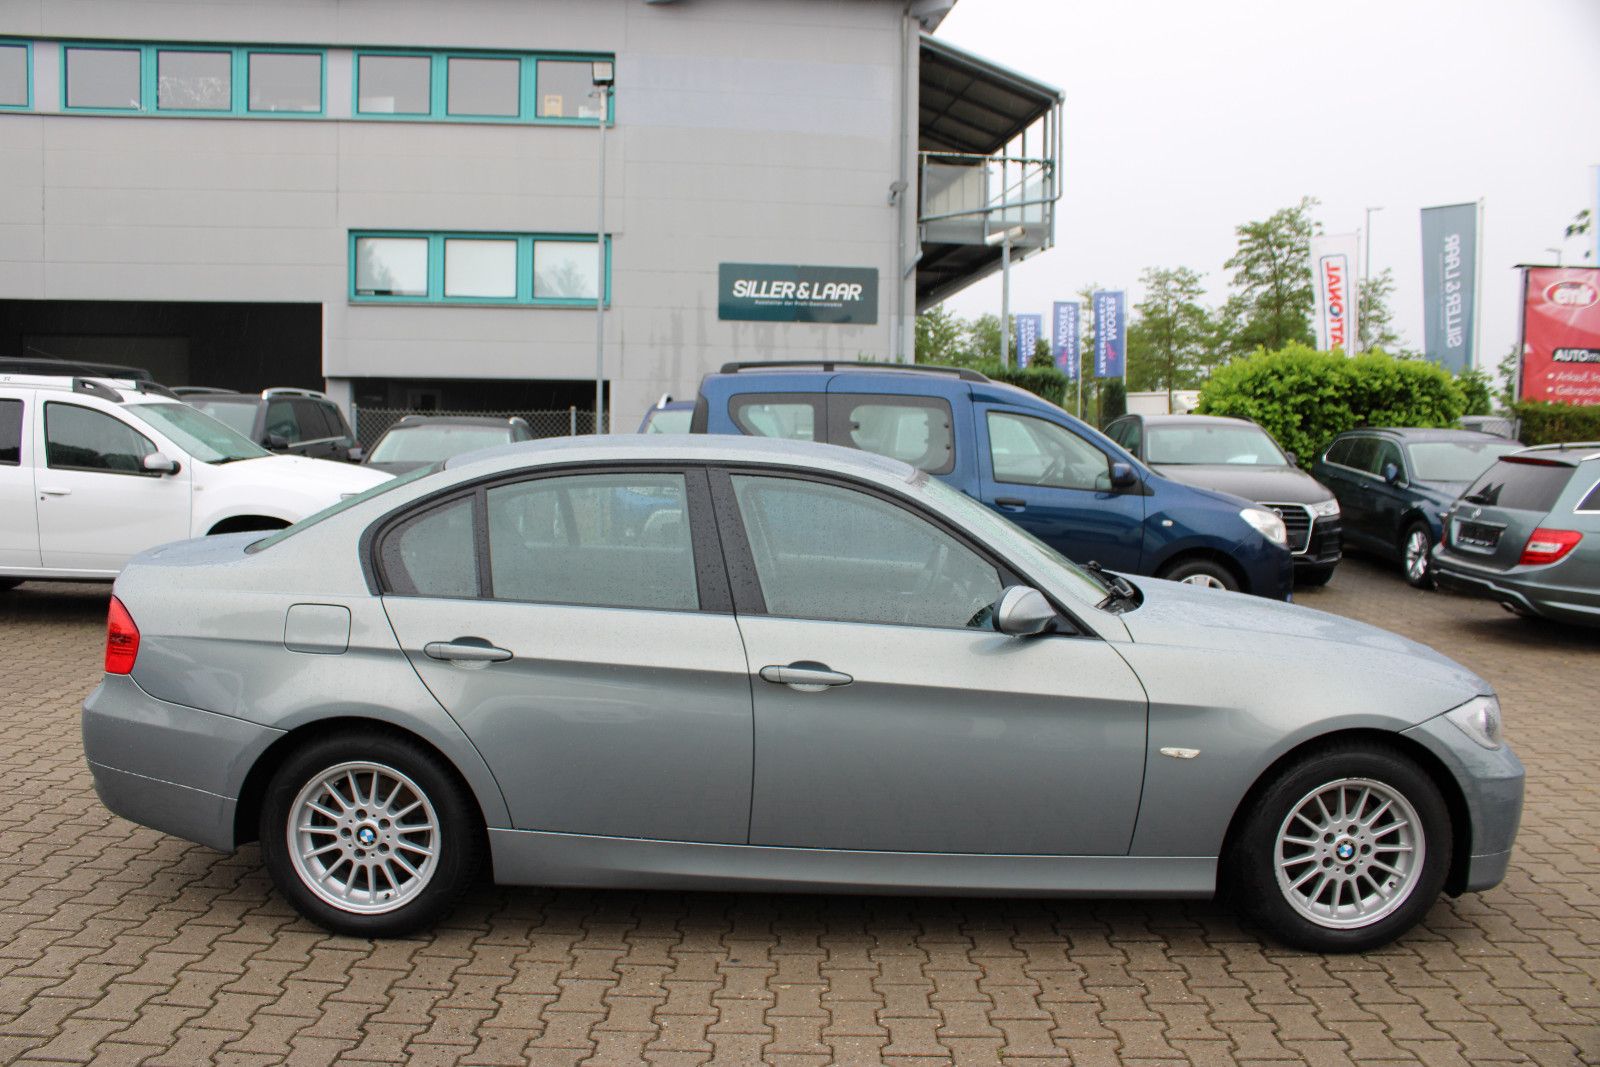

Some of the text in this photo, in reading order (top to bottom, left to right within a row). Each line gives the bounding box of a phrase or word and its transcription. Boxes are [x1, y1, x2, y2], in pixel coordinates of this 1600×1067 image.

[733, 280, 862, 301] SILLER & LAAR
